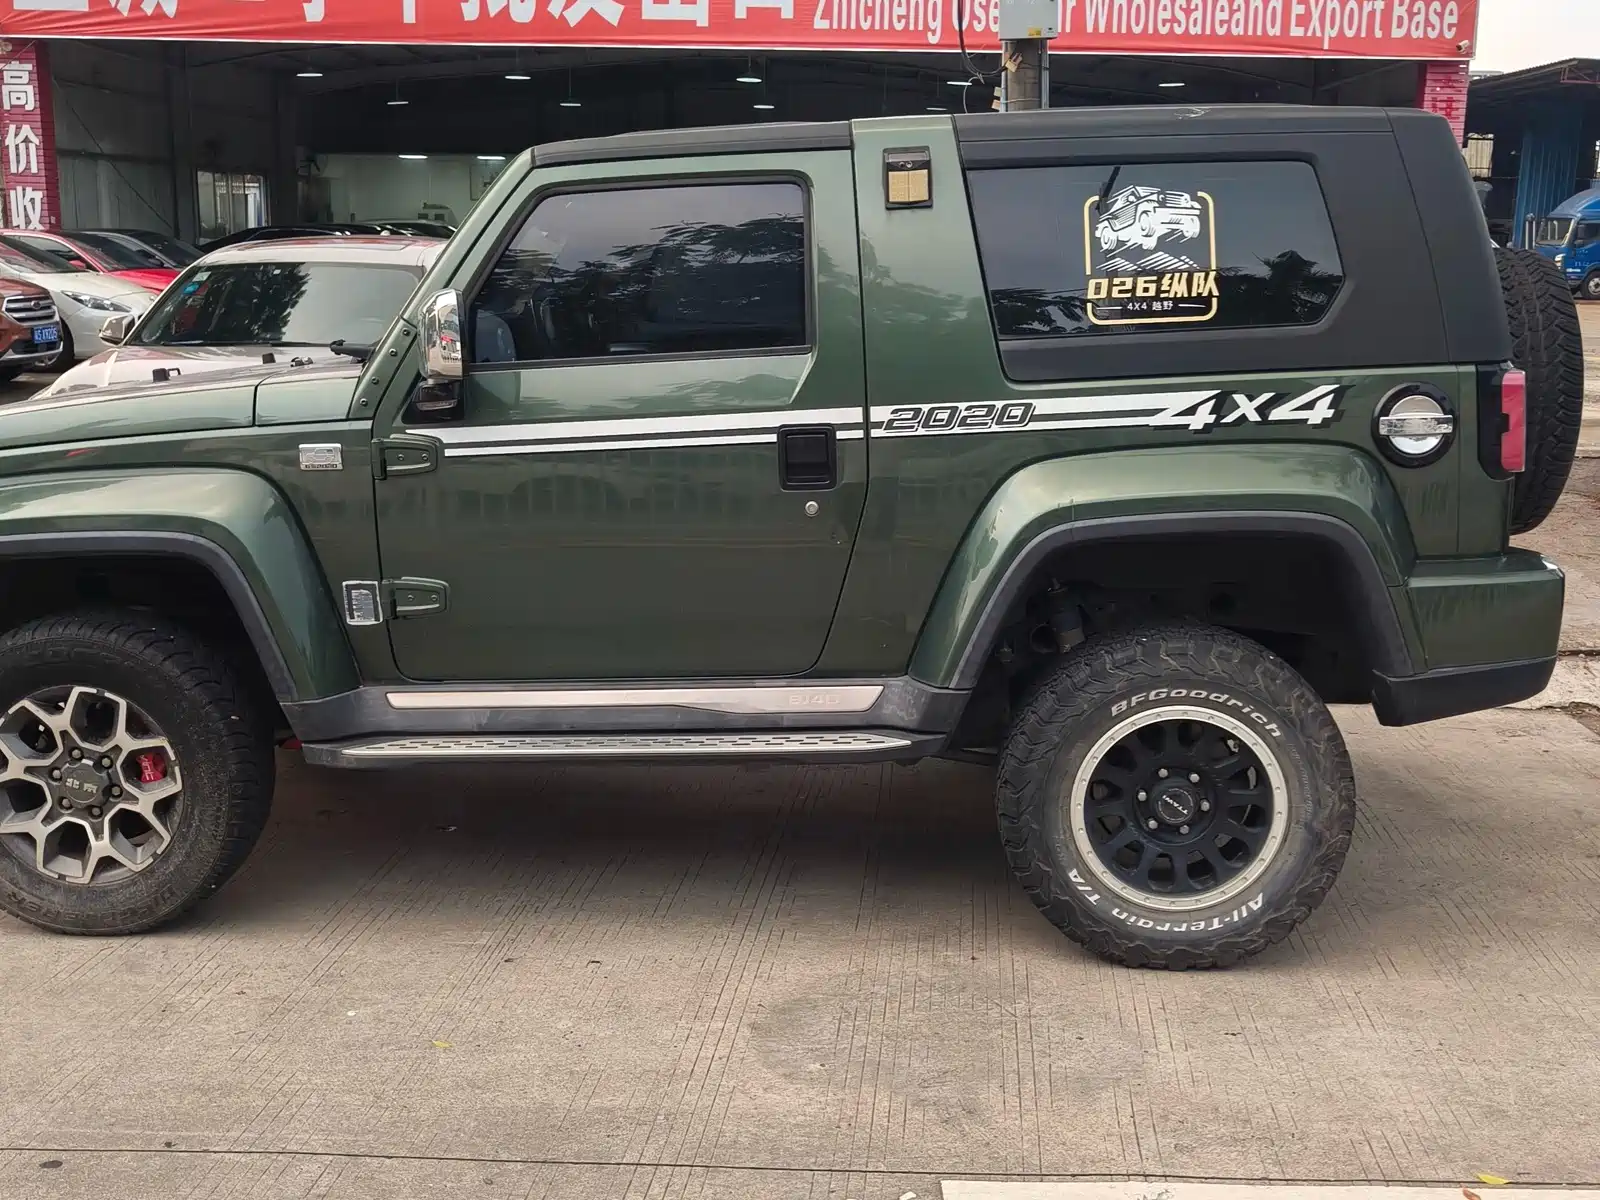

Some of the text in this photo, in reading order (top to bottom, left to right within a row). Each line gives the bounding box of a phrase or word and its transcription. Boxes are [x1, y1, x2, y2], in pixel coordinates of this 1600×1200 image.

[952, 0, 999, 32] Use
[1289, 0, 1383, 50] Export
[1391, 0, 1459, 38] Base
[1086, 270, 1220, 299] 026纵队
[882, 402, 1036, 433] 2020
[1111, 688, 1283, 738] BFGoodrich
[1068, 868, 1264, 932] All-Terrain T/A
